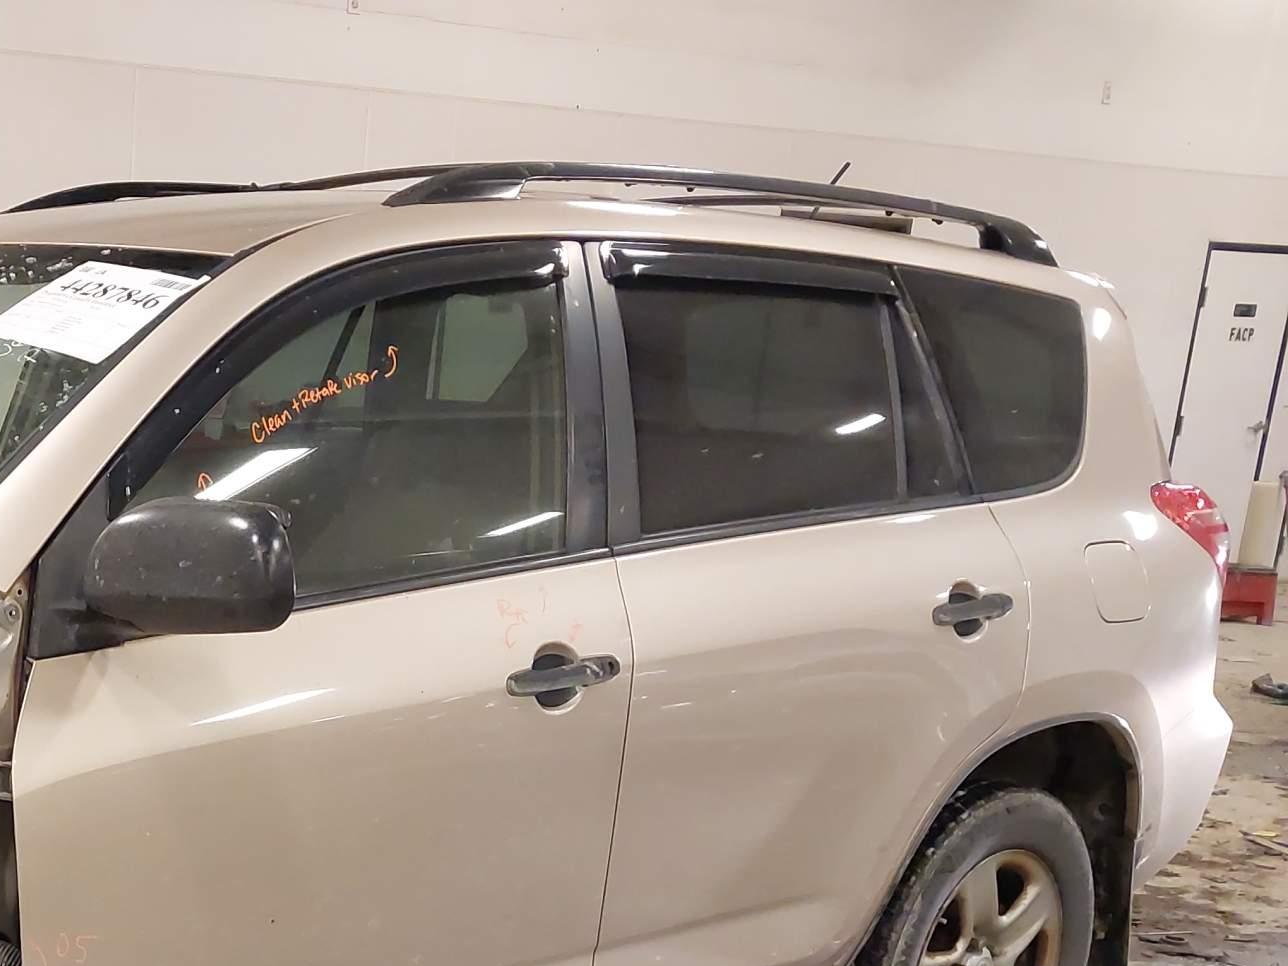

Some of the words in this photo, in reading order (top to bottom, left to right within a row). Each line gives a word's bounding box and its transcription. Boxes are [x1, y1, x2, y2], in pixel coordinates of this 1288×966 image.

[59, 278, 170, 310] 44287846
[1229, 327, 1255, 341] FACP
[251, 408, 292, 443] Clean
